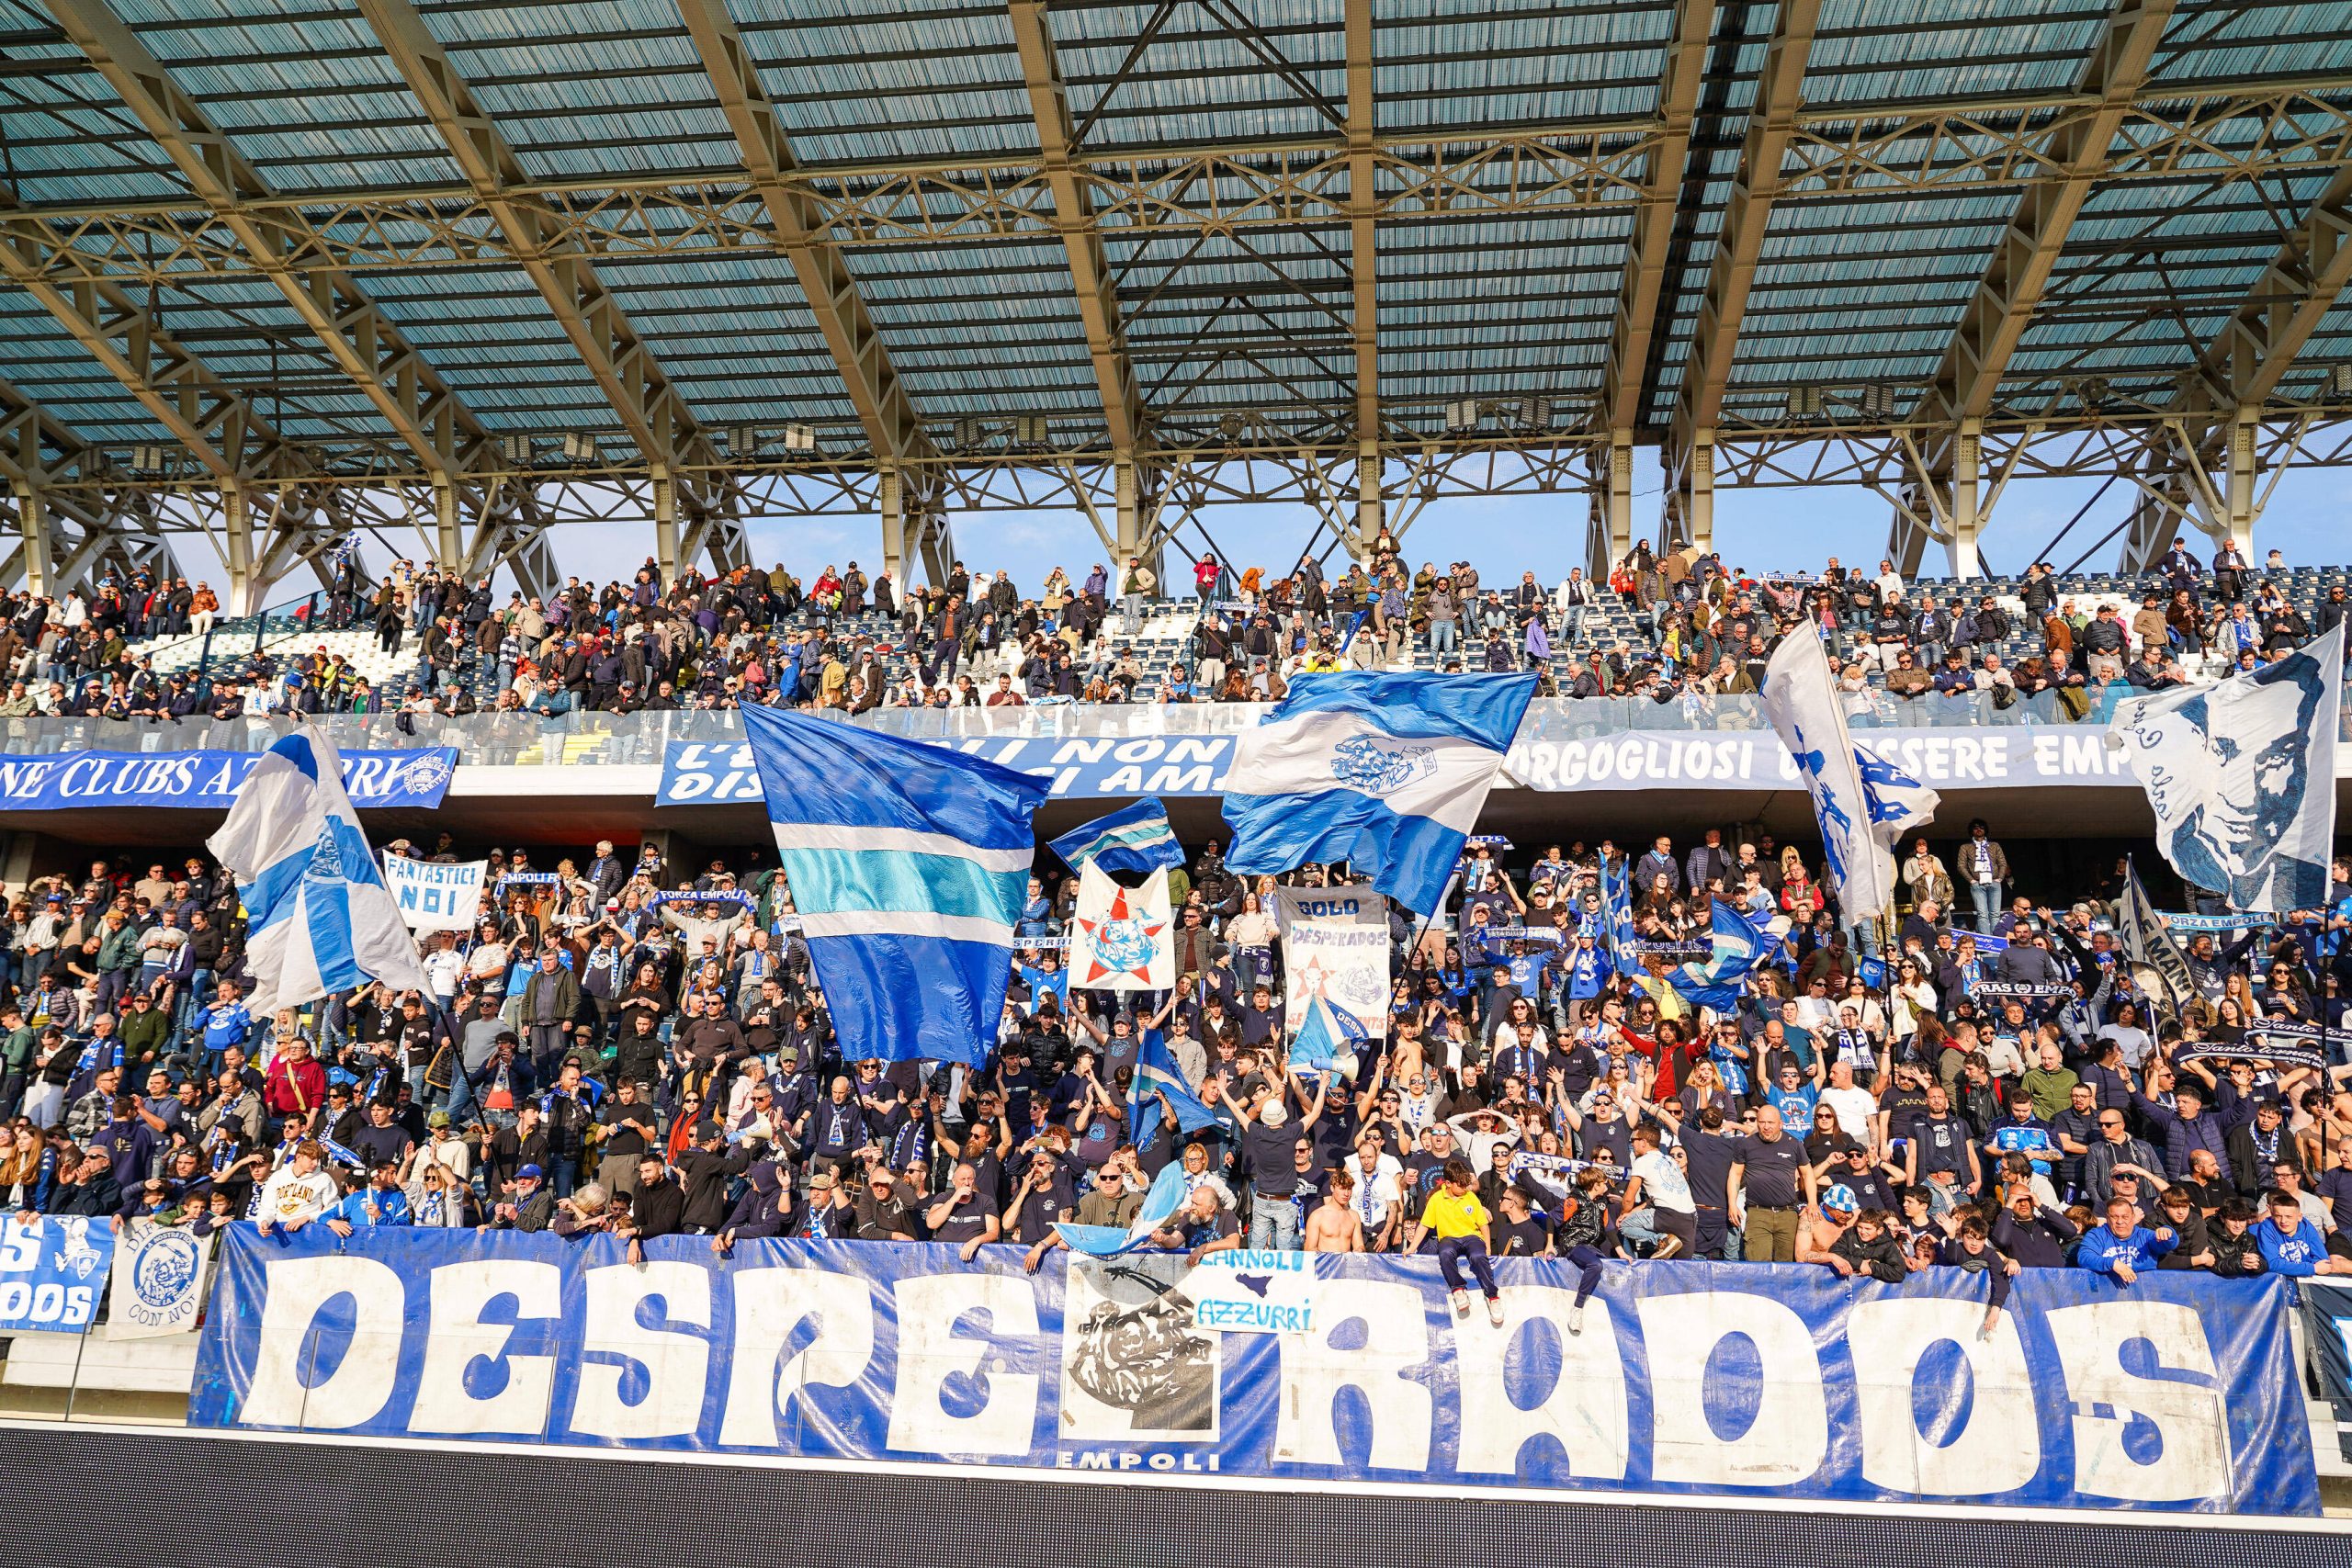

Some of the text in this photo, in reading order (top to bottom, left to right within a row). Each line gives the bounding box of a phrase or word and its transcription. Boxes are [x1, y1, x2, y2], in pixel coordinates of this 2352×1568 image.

[1050, 739, 1230, 763] NON
[1858, 736, 2008, 781] SSERE
[2033, 735, 2131, 776] EMP
[59, 757, 201, 797] CLUBS
[198, 757, 405, 796] AZRI
[1099, 765, 1227, 792] AM
[388, 858, 476, 885] FANTASTICI
[501, 873, 549, 883] EMPOLI
[399, 885, 457, 916] NOI
[661, 889, 744, 900] FORZA EMPOLI
[1296, 898, 1360, 917] SOLO
[2212, 914, 2265, 928] EMPOLI
[1293, 928, 1387, 947] DESPERADOS
[2144, 935, 2192, 993] MANI
[1976, 983, 2076, 999] RAS EMPO
[2253, 1016, 2317, 1033] Tanto
[2192, 1043, 2254, 1054] Tanto
[277, 1182, 314, 1204] PORTLAND
[154, 1231, 180, 1244] NOSTRA
[129, 1303, 164, 1326] CON
[1198, 1298, 1313, 1332] AZZURRI
[1057, 1450, 1220, 1472] EMPOLI
